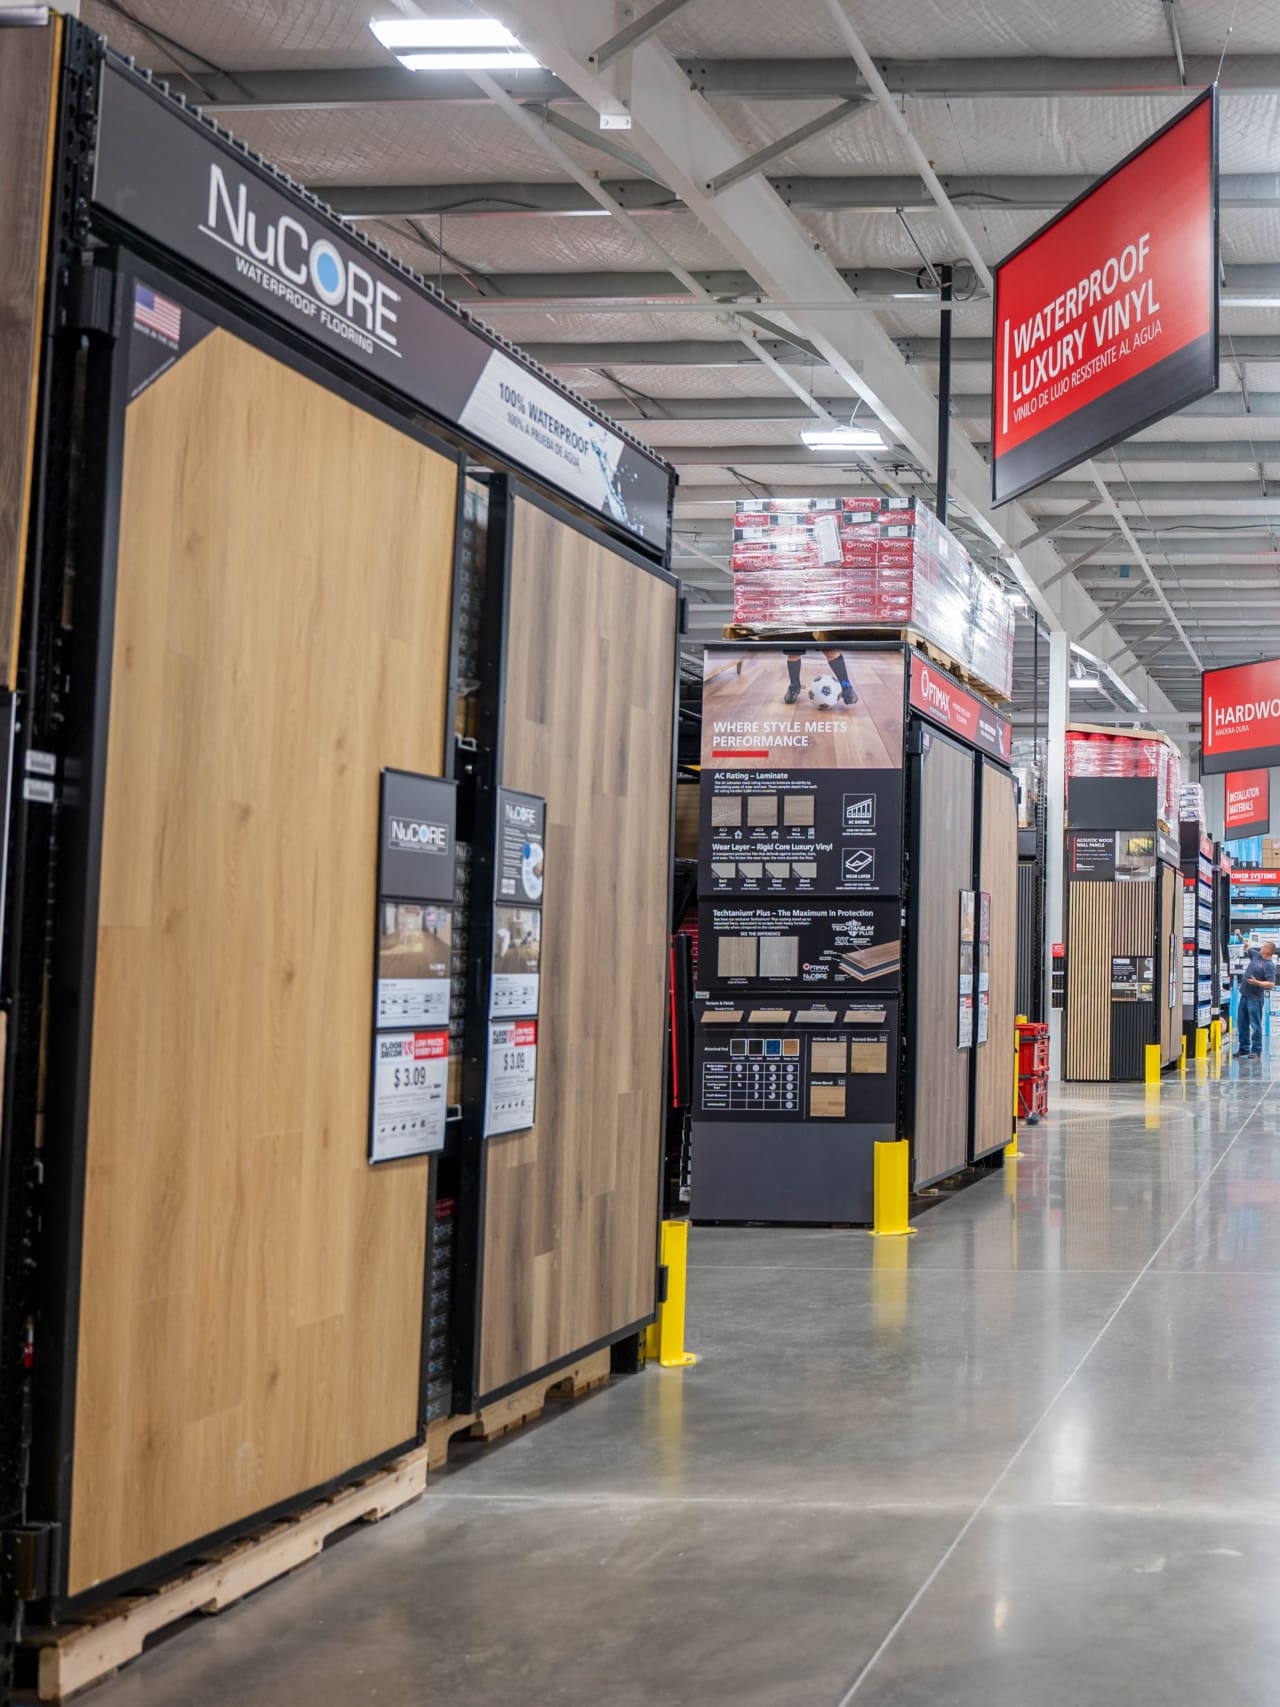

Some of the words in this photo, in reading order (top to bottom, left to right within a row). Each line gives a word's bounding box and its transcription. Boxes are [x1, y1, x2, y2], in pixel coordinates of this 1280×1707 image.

[1013, 232, 1151, 356] WATERPROOF
[235, 255, 318, 318] WATERPROOF
[320, 310, 374, 354] FLOORING
[1012, 327, 1087, 403] LUXURY
[1092, 278, 1160, 348] VINYL
[1013, 395, 1038, 424] VINILO
[1037, 390, 1049, 410] DE
[1049, 376, 1071, 404] LUJO
[1071, 351, 1117, 390] RESISTENTE
[1118, 343, 1131, 362] AL
[1133, 322, 1163, 353] AGUA
[500, 382, 526, 415] 100%
[528, 400, 590, 457] WATERPROOF
[849, 500, 875, 509] OPTIMAX
[738, 515, 765, 523] OPTIMAX
[884, 512, 911, 522] OPTIMAX
[846, 541, 873, 549] OPTIMAX
[882, 540, 909, 549] OPTIMAX
[845, 555, 872, 563] OPTIMAX
[882, 555, 909, 563] OPTIMAX
[921, 668, 951, 720] OPTIMAX
[713, 721, 759, 733] WHERE
[763, 721, 801, 733] STYLE
[804, 721, 847, 733] MEETS
[1215, 726, 1235, 736] MADERA
[1235, 725, 1250, 734] DURA
[712, 735, 809, 747] PERFORMANCE
[726, 772, 749, 780] Rating
[1230, 787, 1260, 802] INSTALLATION
[1230, 800, 1253, 814] MATERIALS
[731, 843, 750, 851] Layer
[757, 843, 774, 851] Rigid
[791, 843, 814, 852] Luxury
[815, 843, 833, 852] Vinyl
[381, 1040, 403, 1050] FLOOR
[381, 1049, 403, 1059] DECOR
[503, 1052, 509, 1071] $
[510, 1051, 525, 1070] 3.09
[393, 1068, 401, 1089] $
[403, 1066, 426, 1087] 3.09
